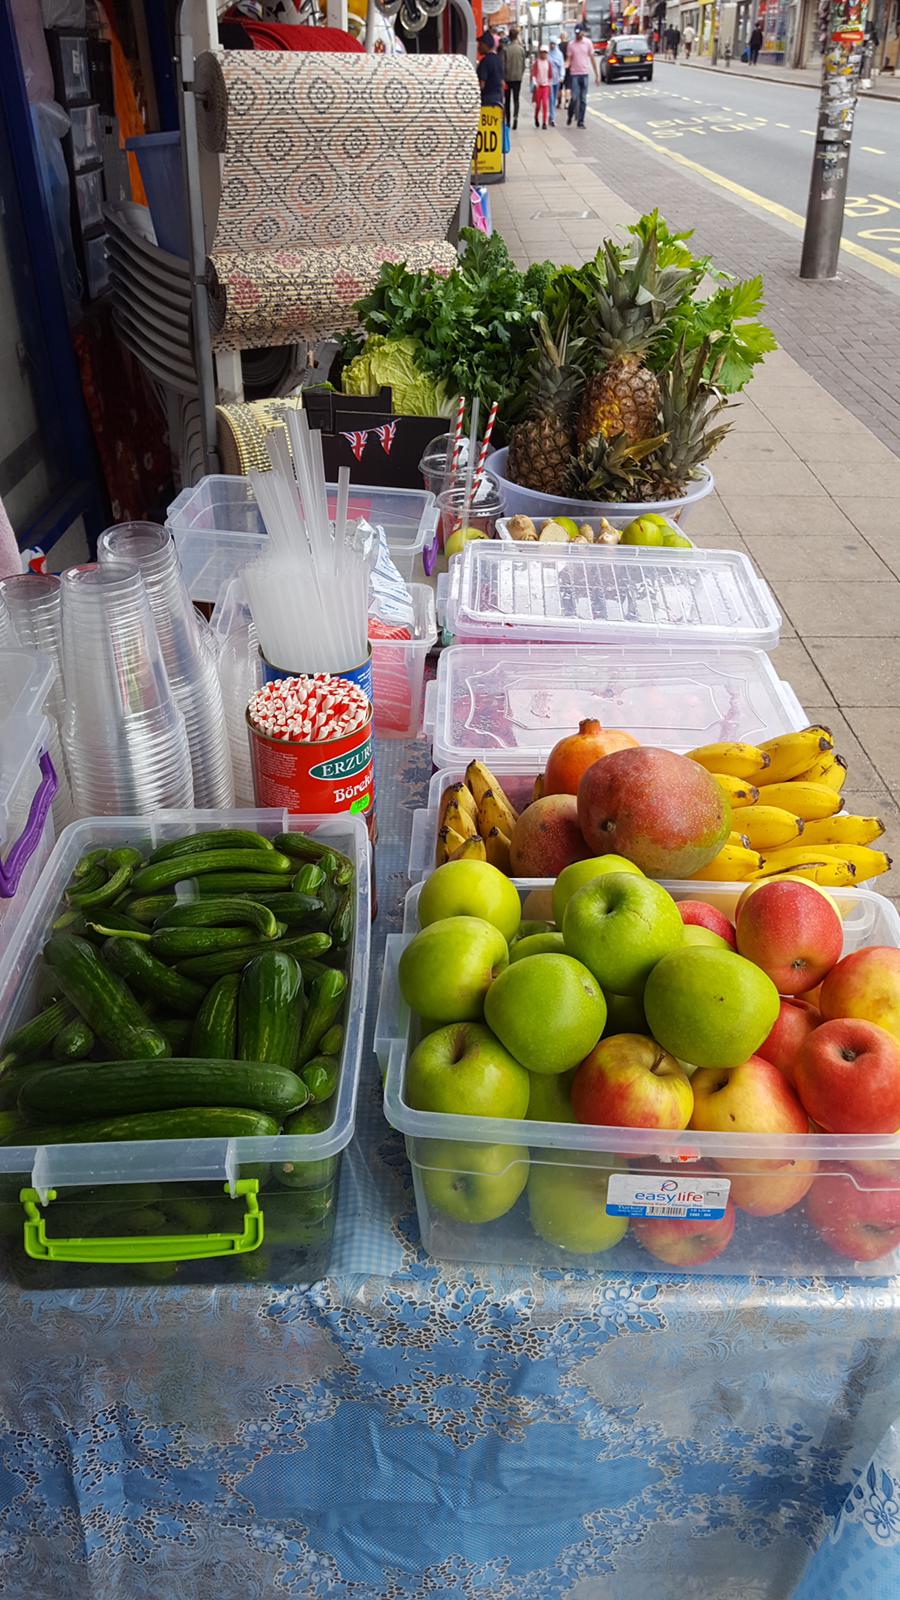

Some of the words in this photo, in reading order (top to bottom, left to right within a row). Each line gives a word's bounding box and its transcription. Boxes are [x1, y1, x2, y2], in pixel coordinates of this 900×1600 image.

[481, 114, 498, 126] BUY
[646, 115, 733, 128] BUS
[651, 122, 766, 139] STOP
[475, 130, 498, 153] OLD
